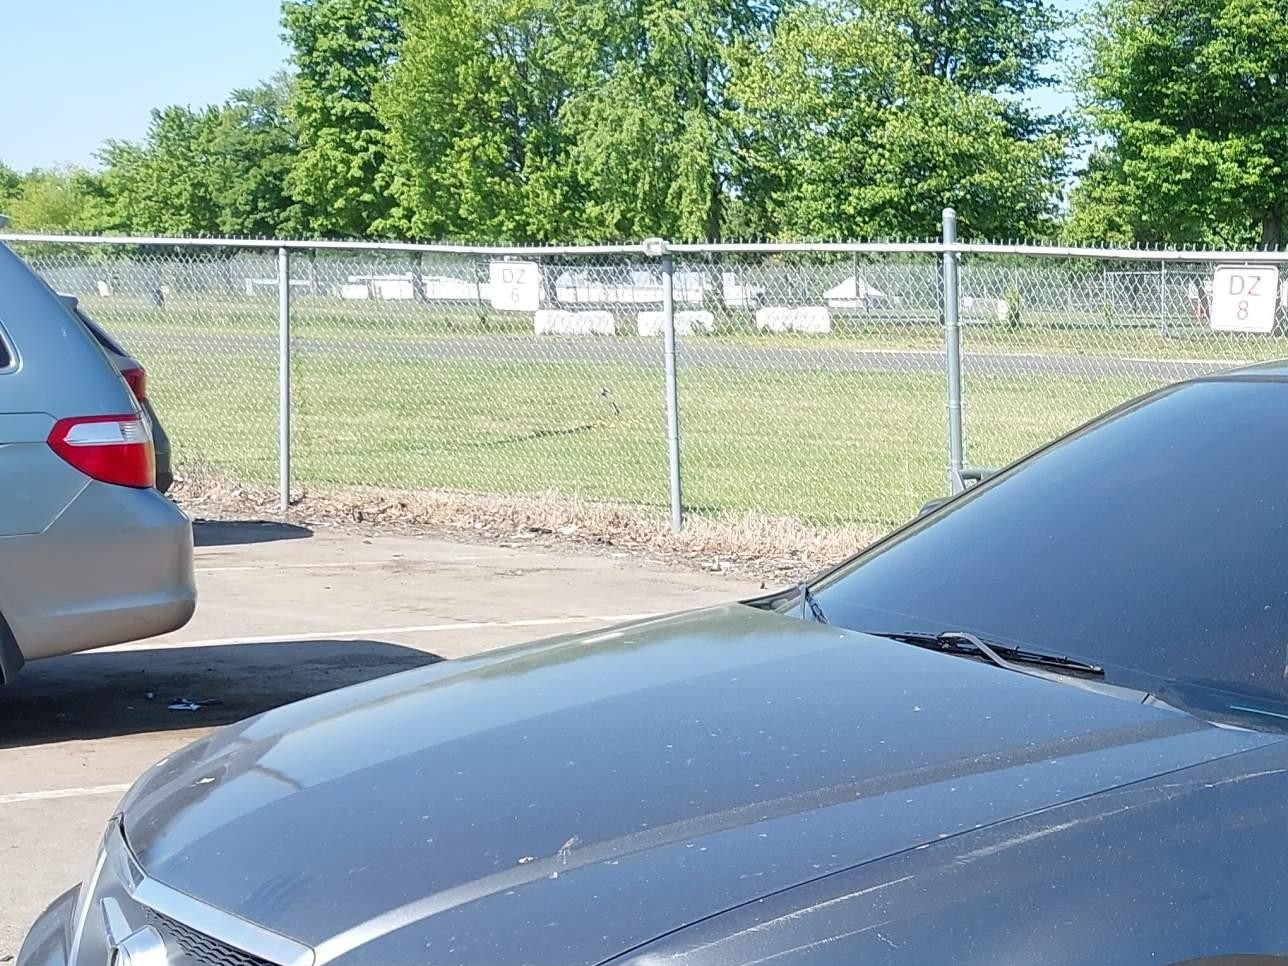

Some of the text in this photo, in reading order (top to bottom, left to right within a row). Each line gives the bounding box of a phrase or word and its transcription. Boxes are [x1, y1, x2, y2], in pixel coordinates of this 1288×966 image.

[502, 268, 526, 285] DZ
[1229, 274, 1261, 296] DZ
[511, 287, 520, 303] 6
[1237, 300, 1249, 320] 8
